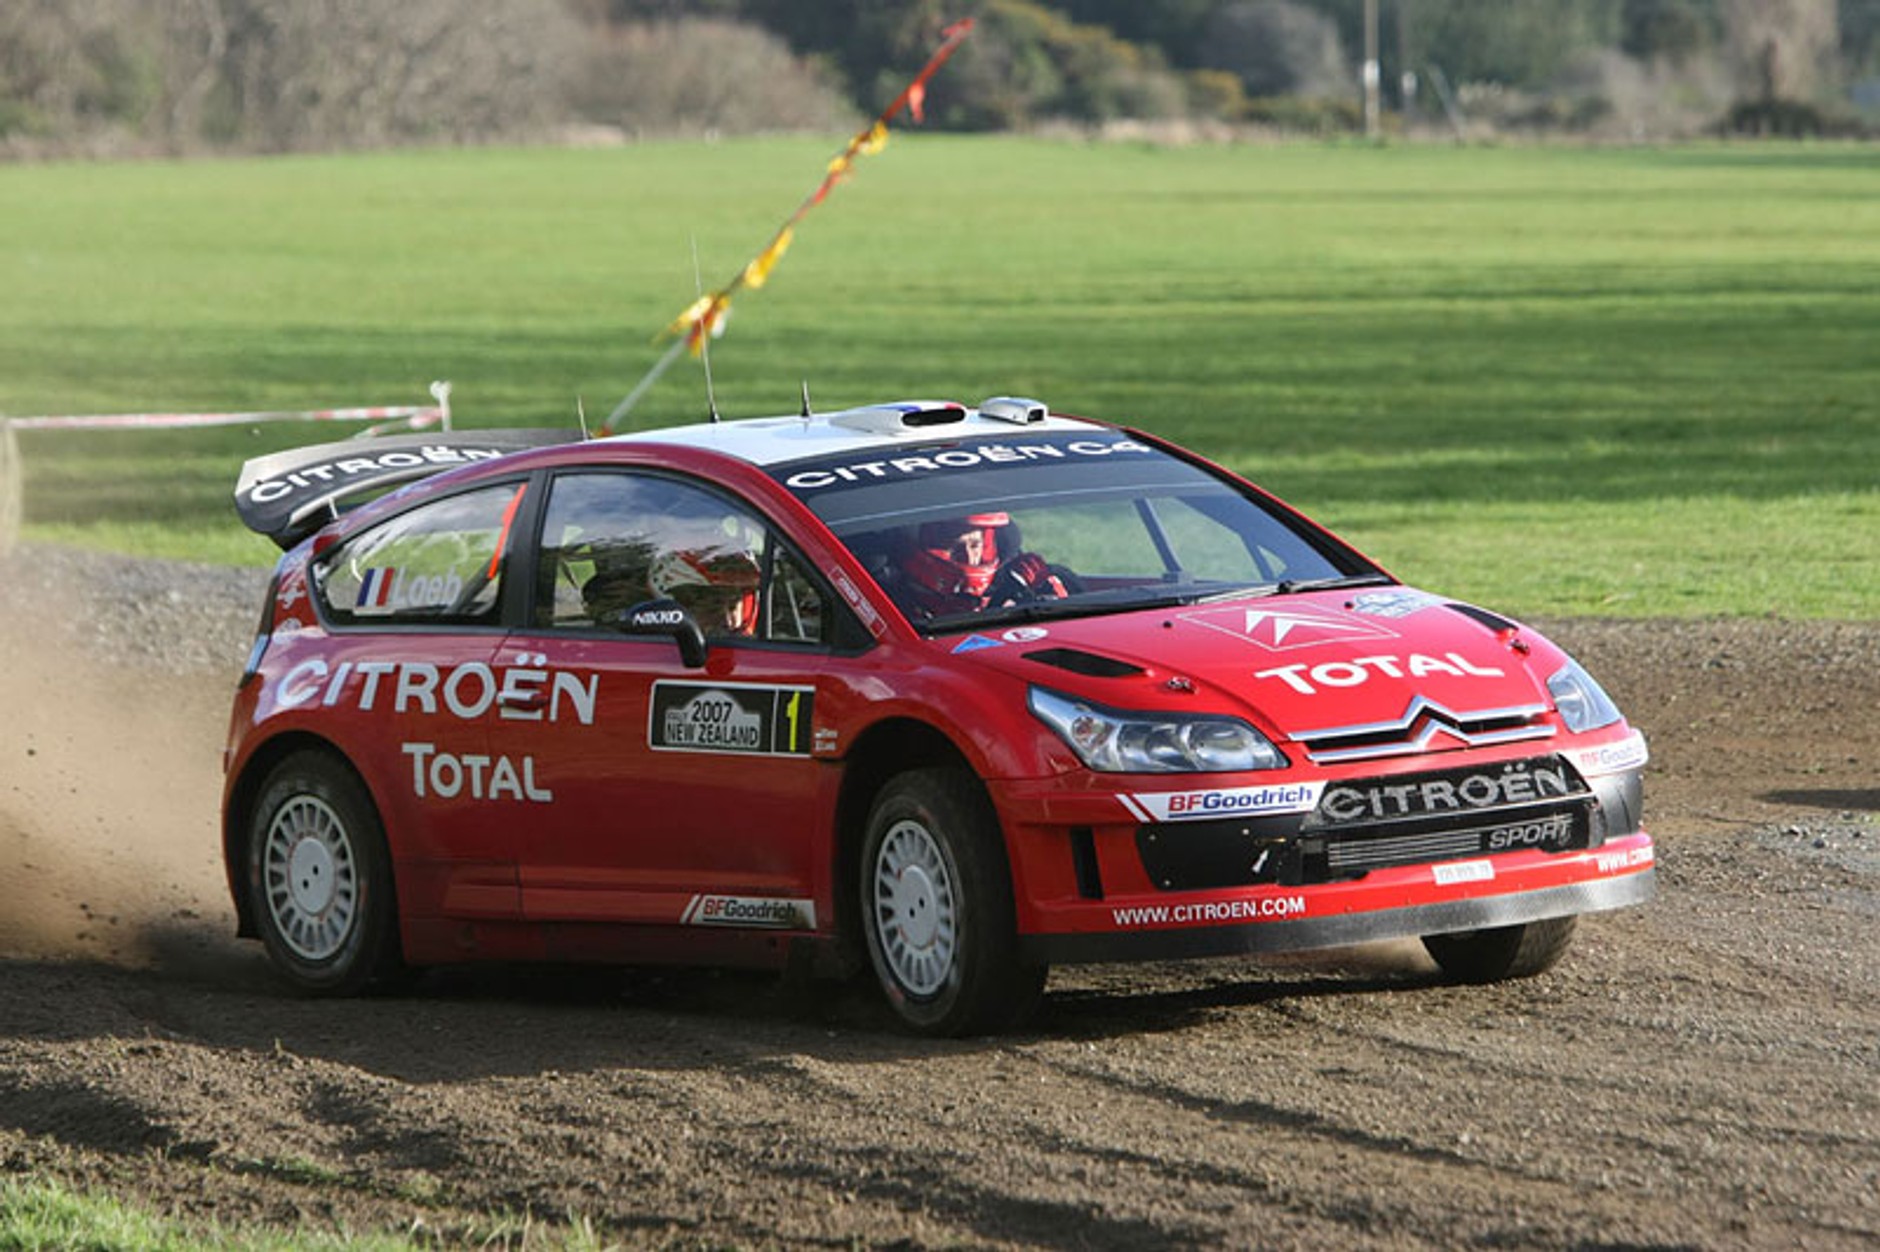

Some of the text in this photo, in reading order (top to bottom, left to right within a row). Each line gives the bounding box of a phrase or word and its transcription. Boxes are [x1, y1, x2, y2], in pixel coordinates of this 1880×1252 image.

[785, 441, 1151, 489] CITROËN C4
[632, 609, 683, 626] NIKKO
[276, 653, 599, 725] CITROËN
[1253, 652, 1506, 695] TOTAL
[691, 700, 733, 723] 2007
[786, 690, 800, 752] 1
[667, 723, 759, 747] NEW ZEALAND
[402, 742, 553, 803] TOTAL
[1167, 786, 1313, 812] BFGoodrich
[1320, 763, 1569, 820] CITROËN
[1488, 817, 1573, 850] SPORT
[703, 899, 797, 919] BFGoodrich
[1113, 896, 1306, 926] WWW.CITROEN.COM
